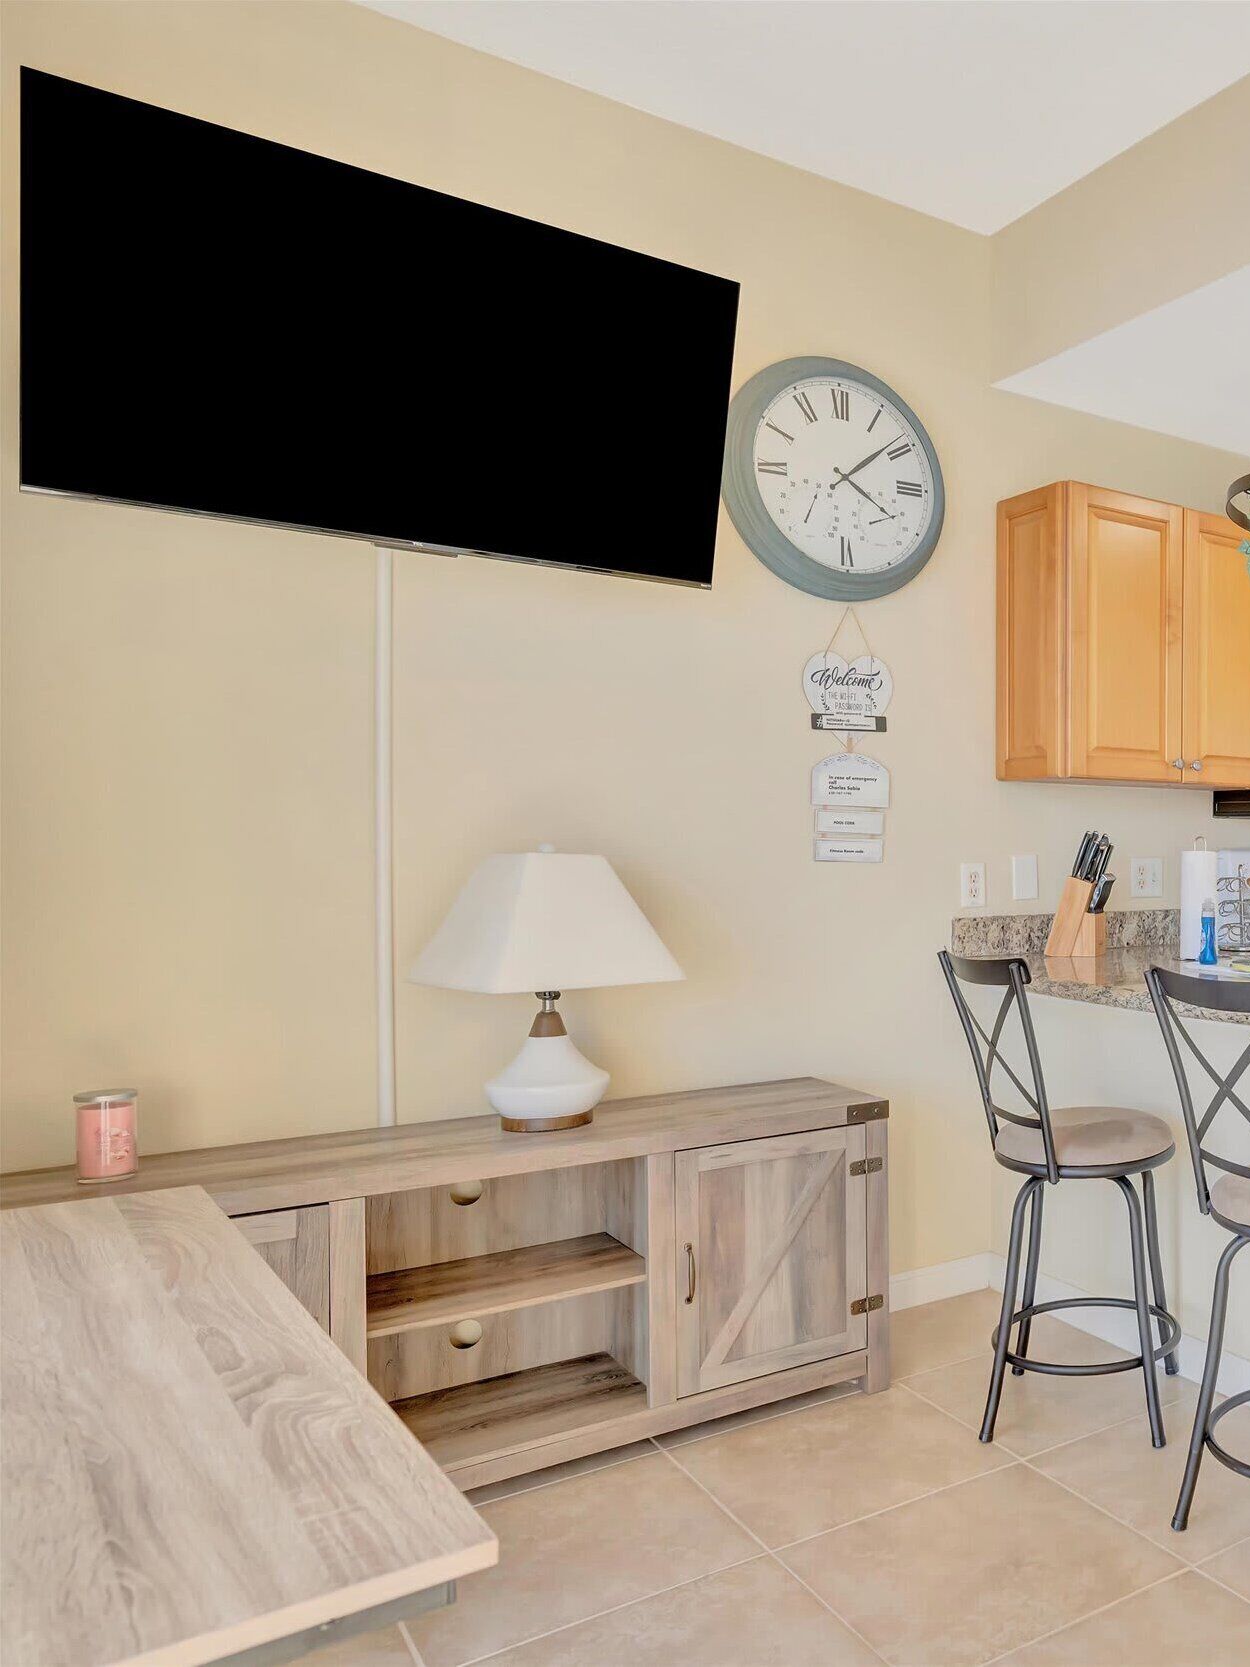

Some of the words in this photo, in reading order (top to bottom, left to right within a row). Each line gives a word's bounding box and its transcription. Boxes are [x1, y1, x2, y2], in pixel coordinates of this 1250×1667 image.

[792, 391, 818, 425] XI
[831, 388, 850, 422] XII
[757, 456, 788, 476] IX
[896, 480, 922, 498] III
[810, 666, 883, 691] Welcome
[828, 691, 838, 700] THE
[840, 692, 857, 701] WI-FI
[834, 702, 864, 711] PASSWORD
[865, 703, 872, 711] IS
